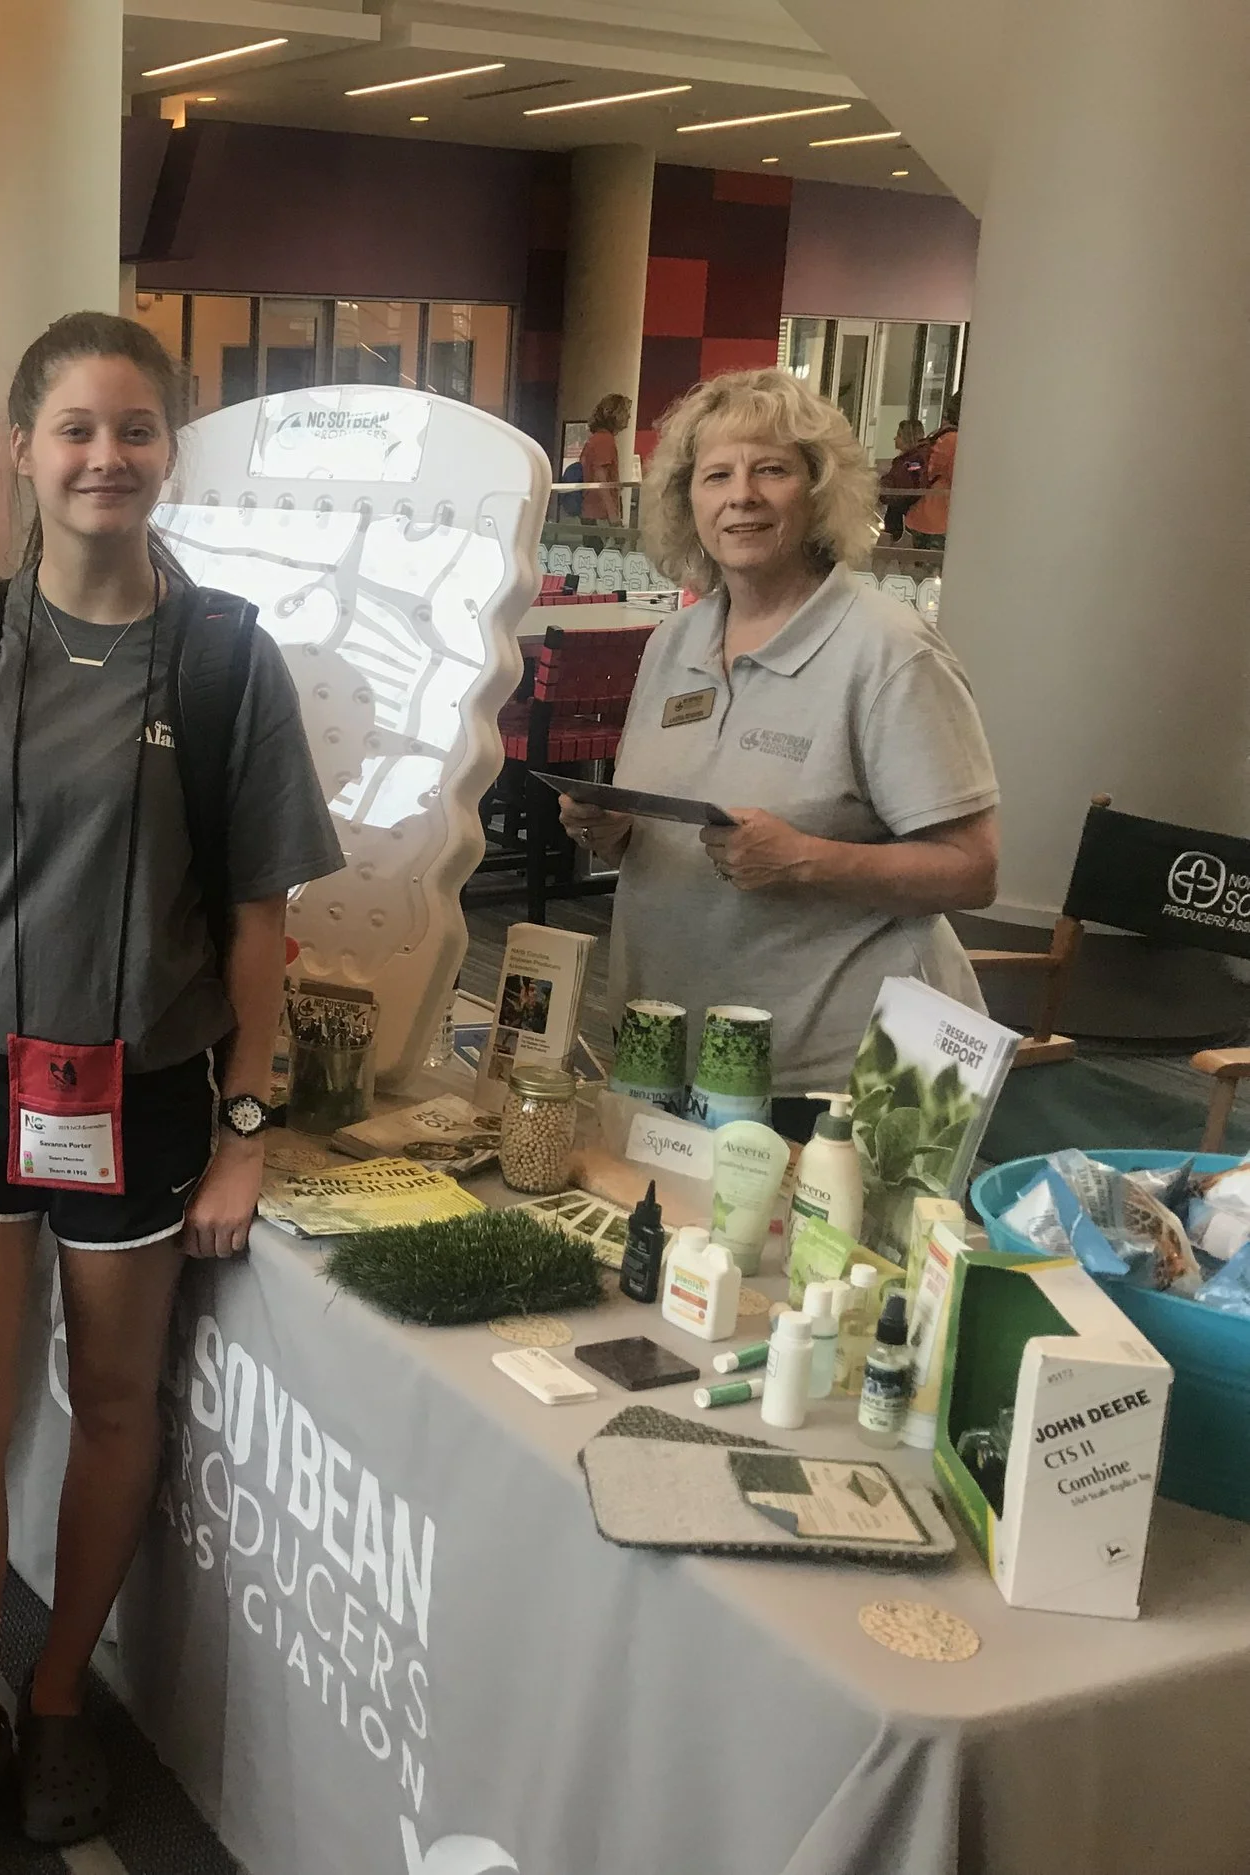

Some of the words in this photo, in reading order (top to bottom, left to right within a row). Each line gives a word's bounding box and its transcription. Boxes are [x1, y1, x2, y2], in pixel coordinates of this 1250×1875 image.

[307, 411, 327, 428] NC
[1161, 903, 1228, 928] PRODUCERS
[944, 1024, 988, 1056] RESEARCH
[939, 1036, 984, 1071] REPORT
[39, 1140, 68, 1149] Savanna
[722, 1140, 771, 1160] Aveeno
[294, 1174, 444, 1197] AGRICULTURE
[1035, 1412, 1086, 1444] JOHN
[1087, 1389, 1151, 1424] DEERE
[1044, 1445, 1079, 1470] CTS
[190, 1315, 436, 1650] SOYBEAN
[1057, 1459, 1132, 1495] Combine
